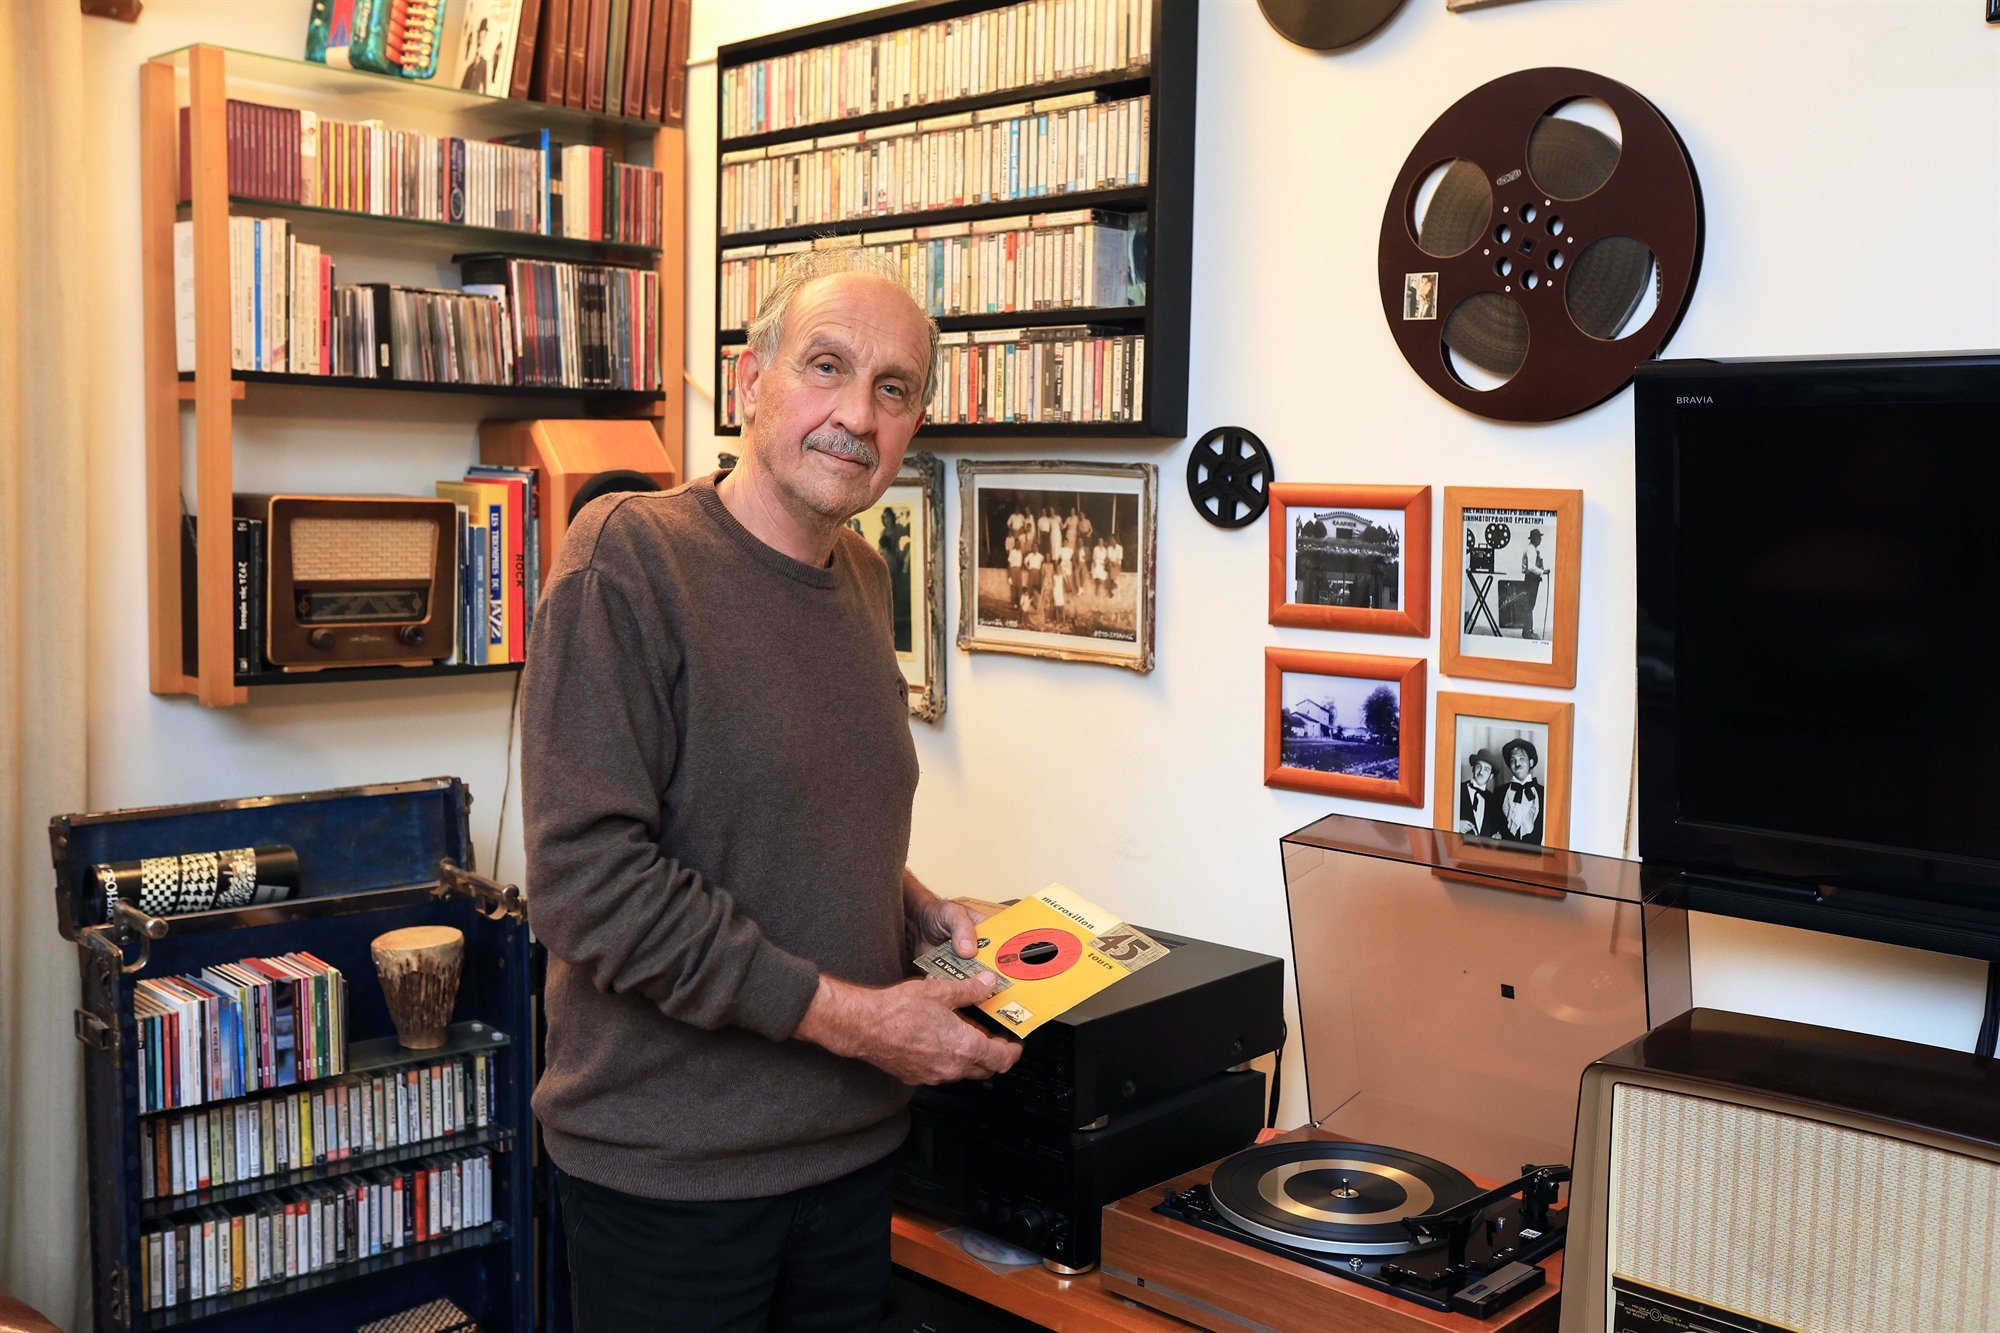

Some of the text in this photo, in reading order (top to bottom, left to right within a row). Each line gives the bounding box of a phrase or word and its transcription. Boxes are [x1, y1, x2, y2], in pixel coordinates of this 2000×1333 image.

[1676, 396, 1713, 404] BRAVIA
[488, 513, 502, 639] LES TRIOMPHES DU JAZZ
[515, 554, 524, 587] ROCK
[1041, 895, 1095, 931] microsillon
[1087, 952, 1114, 970] tours
[1097, 933, 1151, 961] 45
[934, 958, 944, 967] La
[943, 963, 958, 976] Voix
